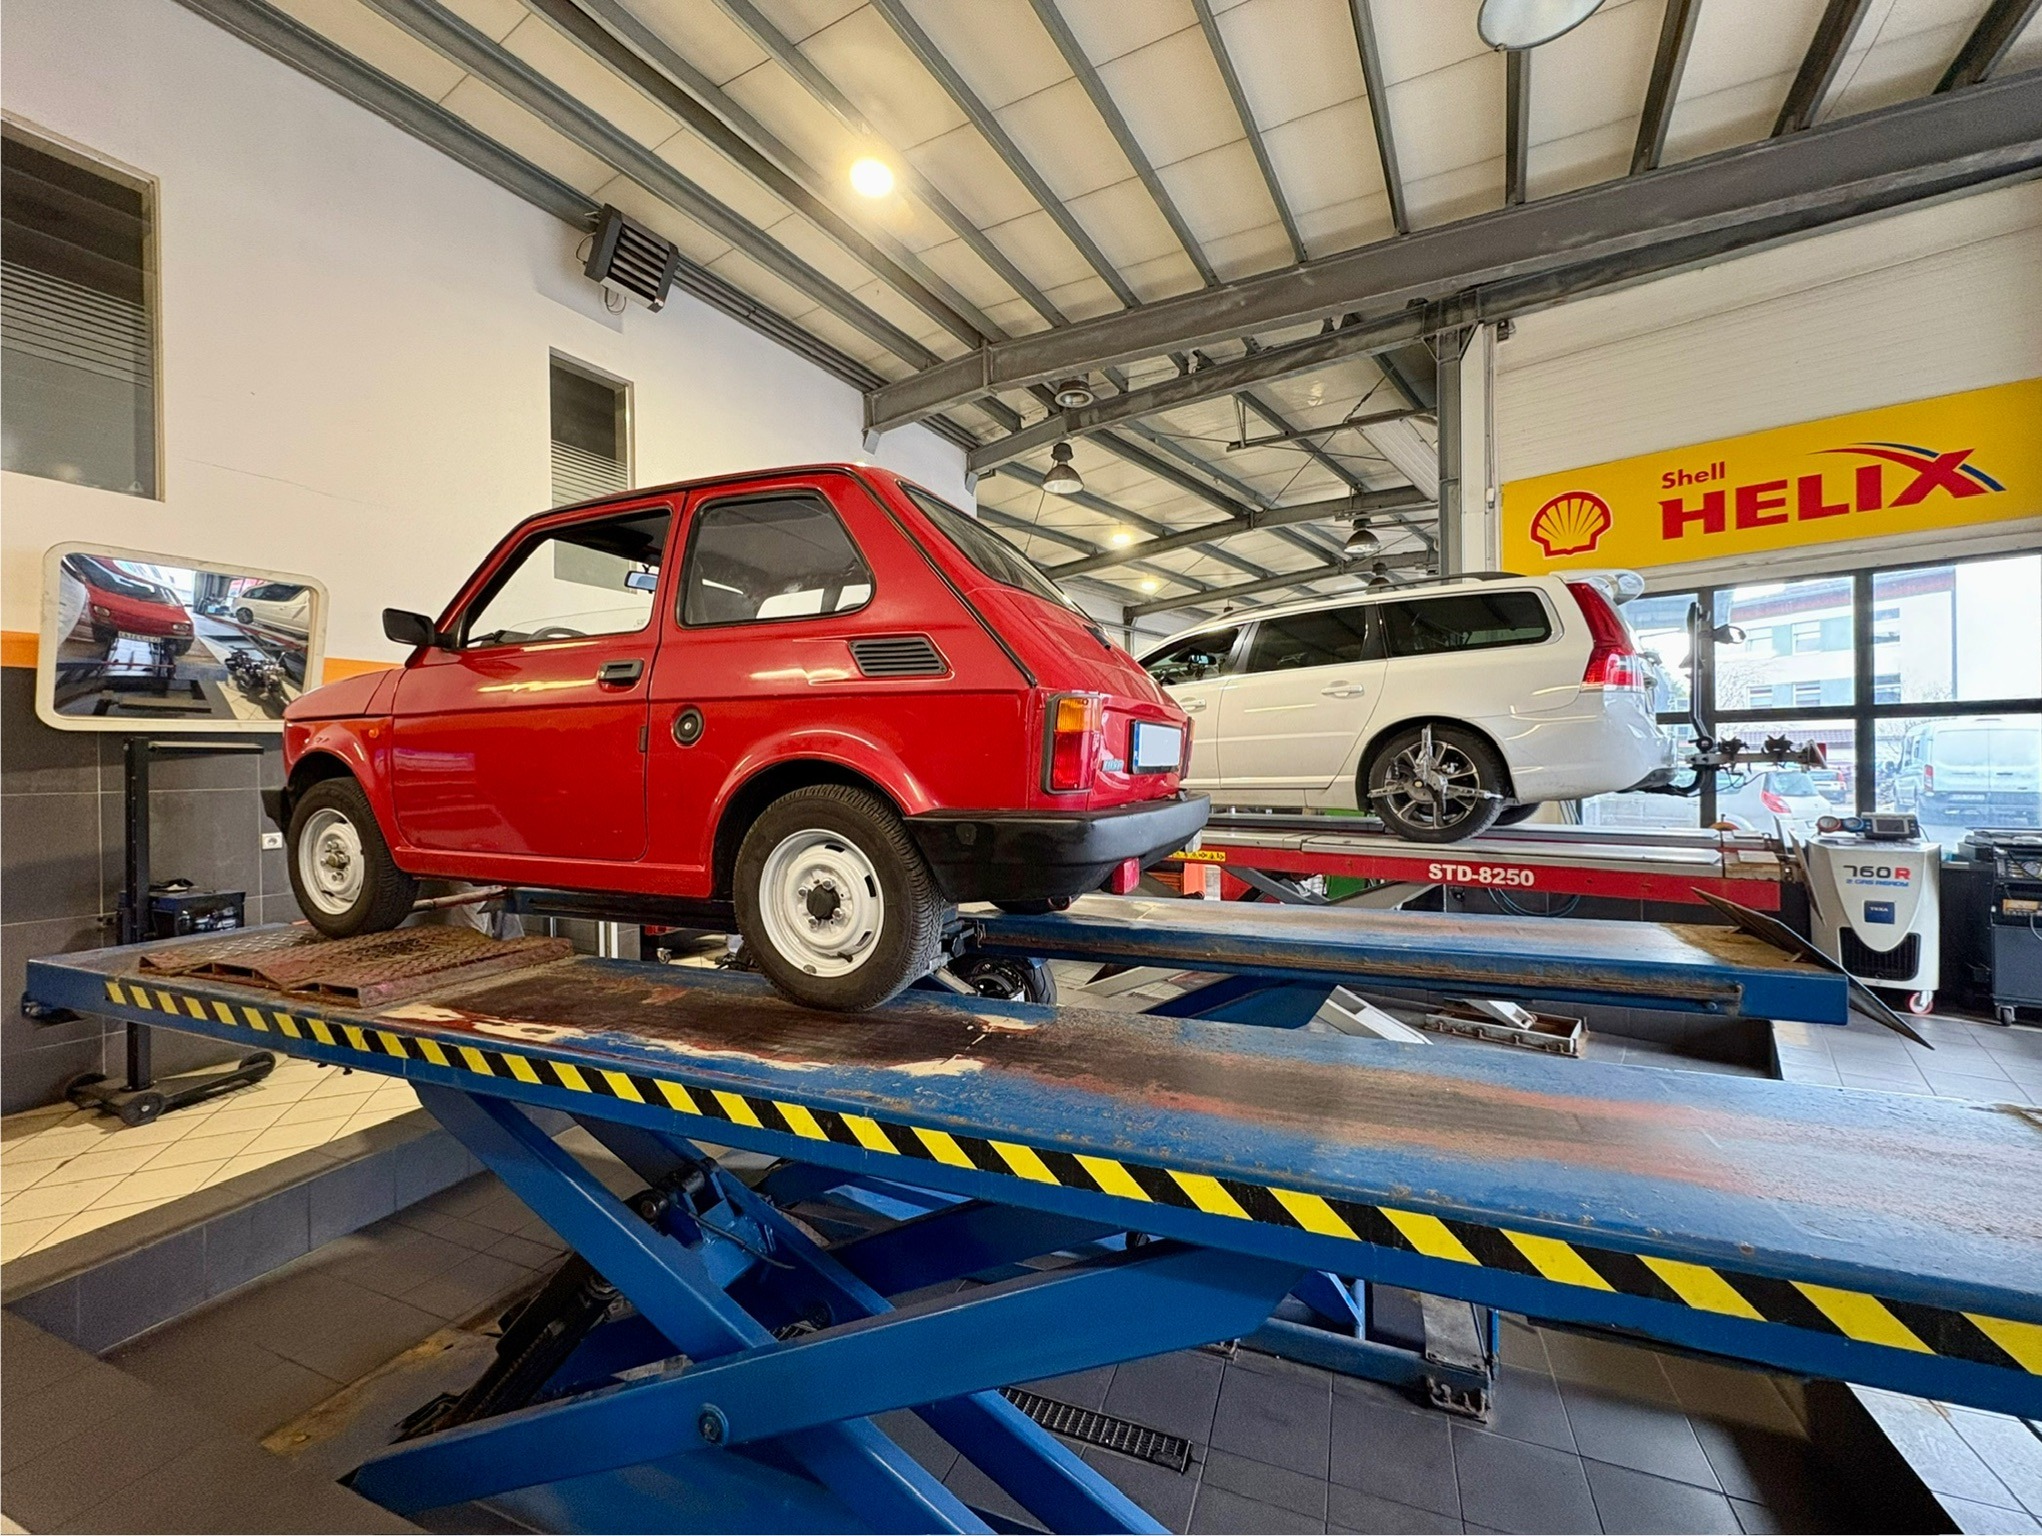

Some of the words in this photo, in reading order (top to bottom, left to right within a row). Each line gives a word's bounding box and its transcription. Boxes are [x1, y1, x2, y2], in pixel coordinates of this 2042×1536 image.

[1661, 461, 1726, 489] Shell
[1658, 448, 1990, 540] HELIX
[1428, 863, 1535, 886] STD-8250
[1843, 865, 1891, 878] 760
[1895, 867, 1911, 879] R
